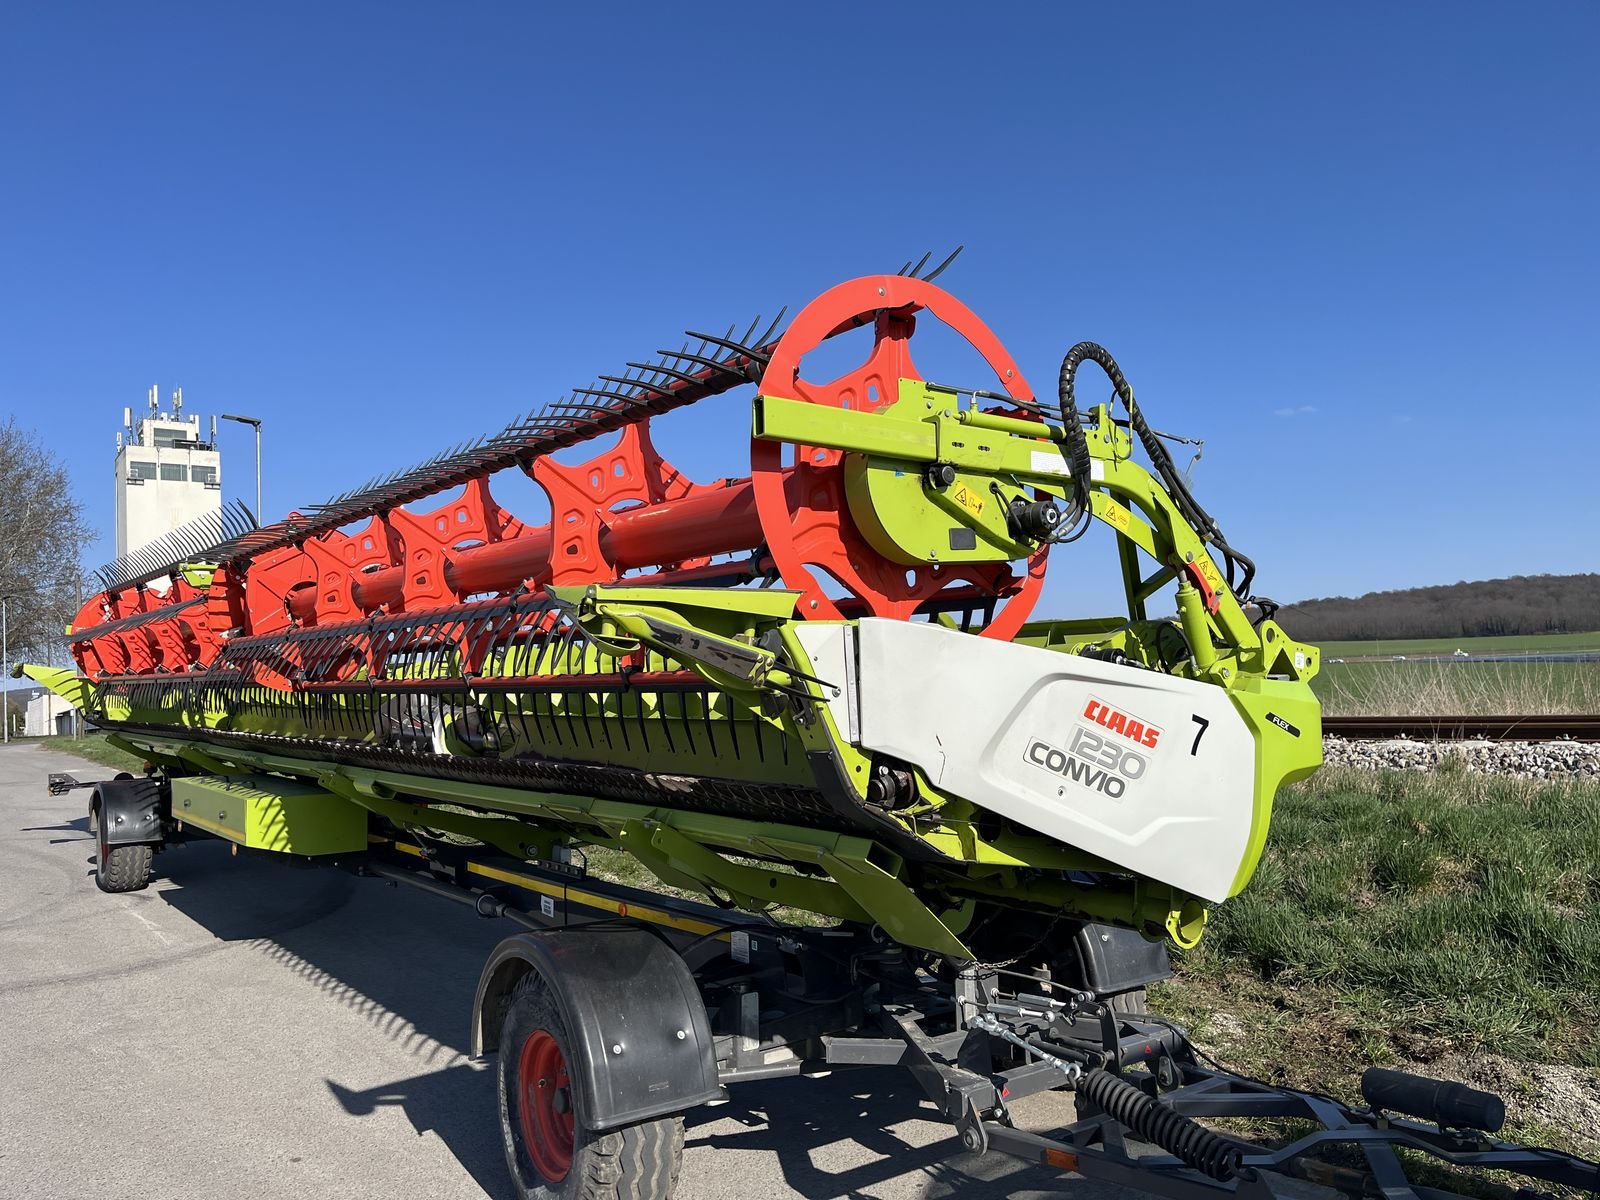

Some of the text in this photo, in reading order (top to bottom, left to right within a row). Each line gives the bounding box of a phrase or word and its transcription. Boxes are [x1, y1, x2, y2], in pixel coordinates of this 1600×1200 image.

[1083, 699, 1160, 749] CLAAS
[1190, 713, 1210, 756] 7
[1272, 716, 1290, 731] FLEX
[1030, 741, 1126, 799] CONVIO
[1069, 727, 1147, 780] 1230
